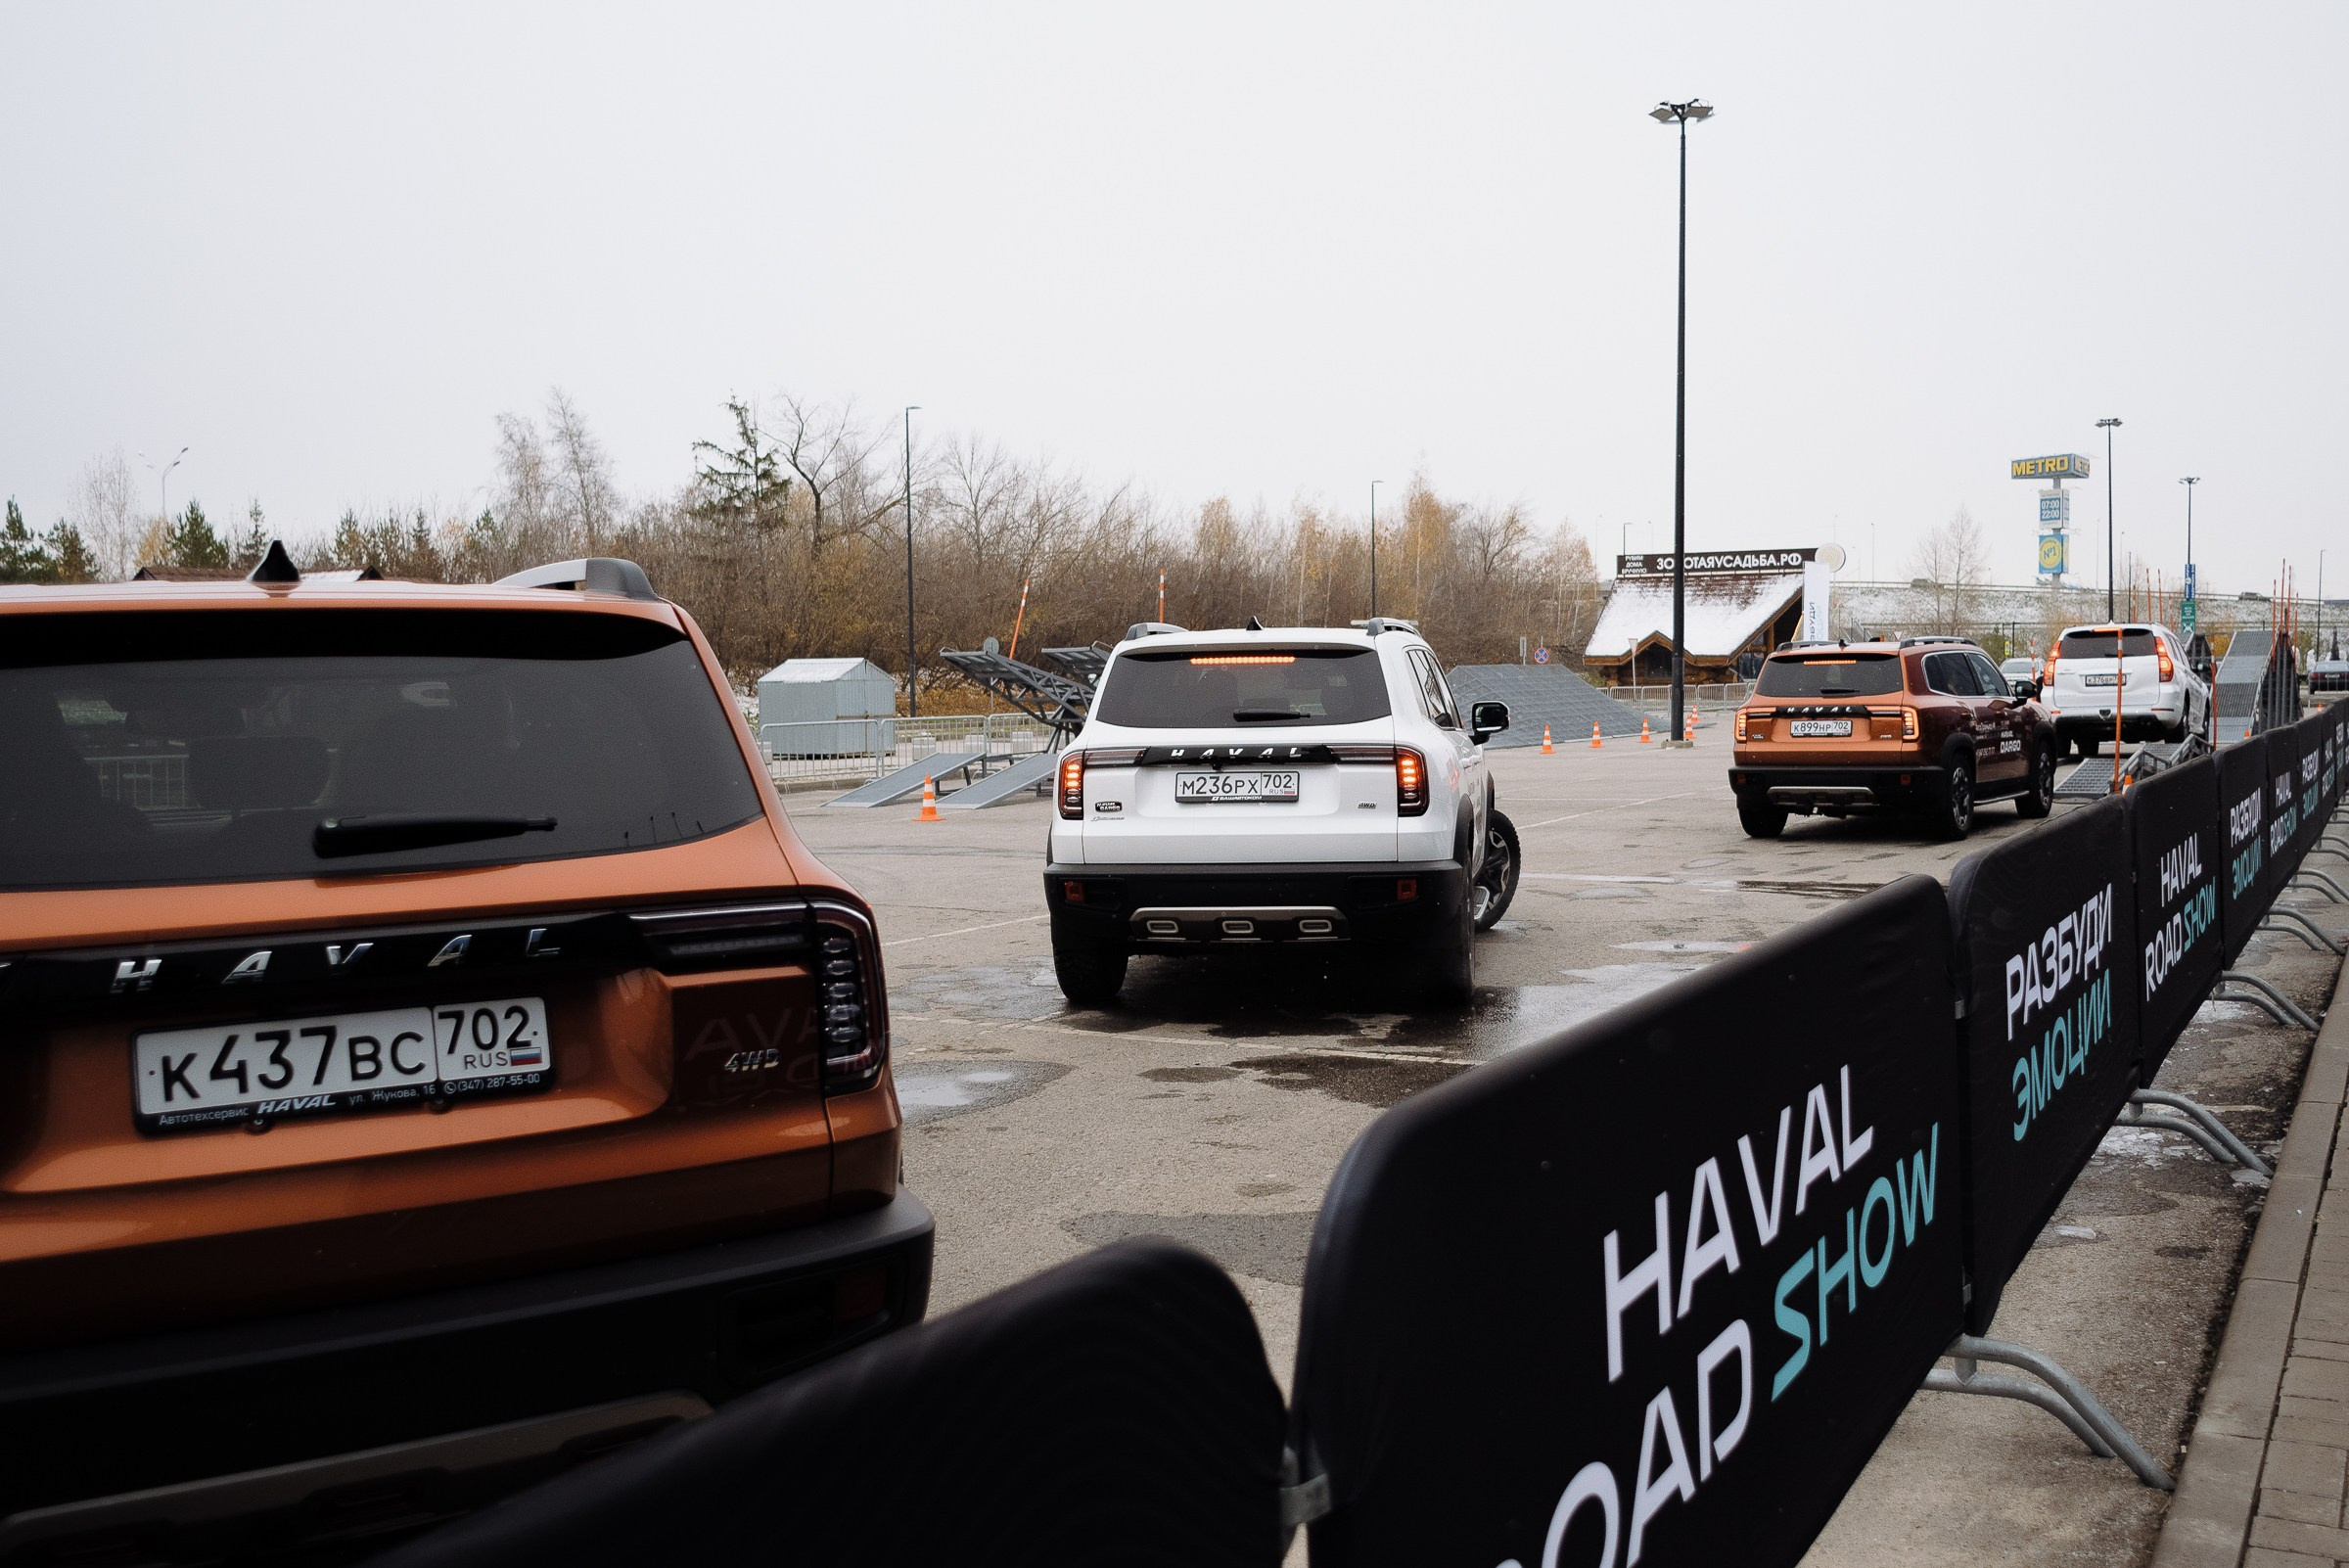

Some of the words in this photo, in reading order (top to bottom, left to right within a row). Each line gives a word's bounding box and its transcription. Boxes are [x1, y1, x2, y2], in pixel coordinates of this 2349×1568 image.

[2012, 456, 2069, 477] METRO
[2041, 499, 2060, 510] 07:00
[2041, 509, 2060, 520] 22:00
[1656, 553, 1802, 571] ЗООТАЯУСАДЬБА.РФ
[1793, 722, 1832, 732] К899НР
[1833, 720, 1849, 730] 702
[2000, 739, 2021, 754] DARGO
[1171, 747, 1302, 760] HAVAL
[1181, 776, 1259, 795] М236РХ
[1263, 774, 1293, 789] 702
[2276, 771, 2291, 807] HAVAL
[2231, 787, 2261, 848] РАЗБУДИ
[2160, 832, 2202, 907] HAVAL
[2232, 835, 2261, 900] ЭМОЦИИ
[112, 928, 562, 992] HAVAL
[2144, 911, 2183, 1002] ROAD
[2183, 875, 2216, 953] SHOW
[2005, 882, 2112, 1042] РАЗБУДИ
[161, 1025, 427, 1102] К437ВС
[438, 1005, 532, 1055] 702
[464, 1050, 508, 1070] RUS
[724, 1048, 780, 1073] 4WD
[2012, 967, 2111, 1143] ЭМОЦИИ
[159, 1106, 250, 1127] Автотехсервис
[256, 1094, 338, 1115] HAVAL
[348, 1093, 366, 1106] ул.
[372, 1087, 420, 1103] Жукова,
[423, 1084, 437, 1095] 16
[458, 1080, 485, 1092] (347)
[486, 1073, 541, 1089] 287-55-00
[1603, 1064, 1874, 1384] HAVAL
[1496, 1318, 1753, 1568] OAD
[1771, 1121, 1939, 1403] SHOW
